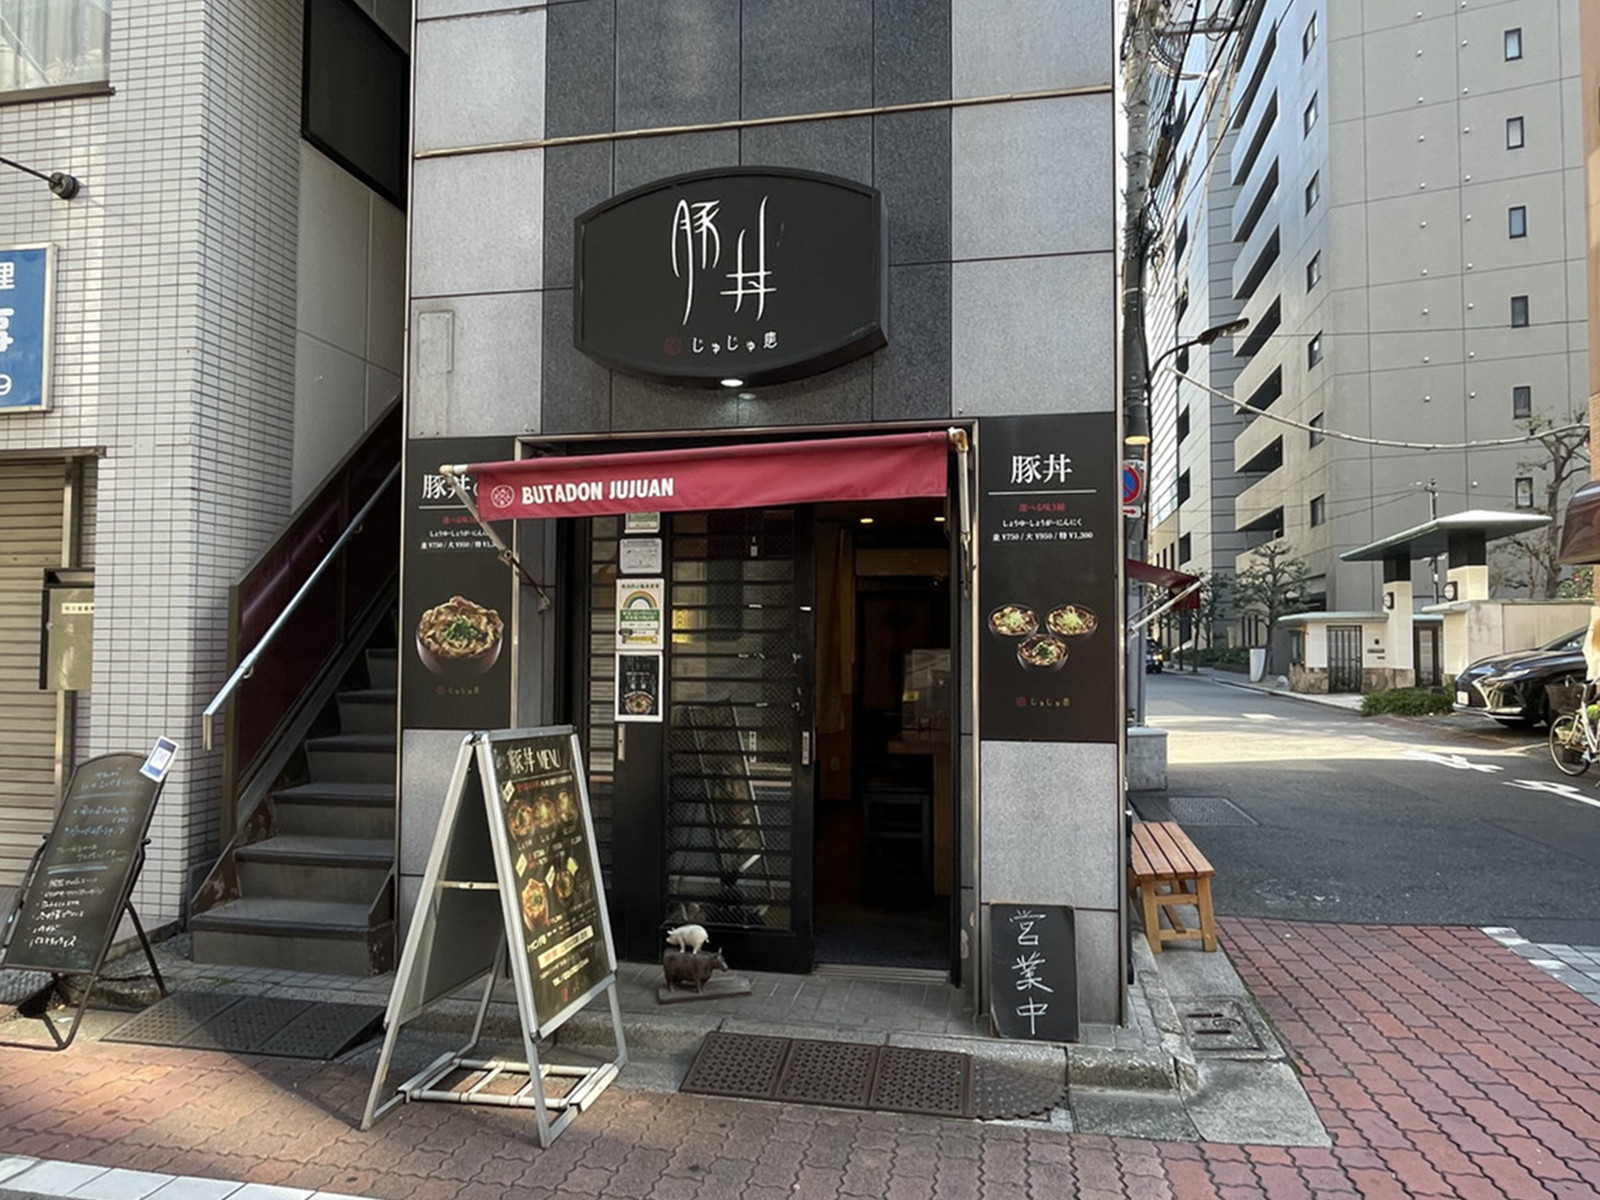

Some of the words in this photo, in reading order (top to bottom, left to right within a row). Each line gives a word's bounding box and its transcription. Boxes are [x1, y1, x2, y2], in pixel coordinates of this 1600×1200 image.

[1010, 453, 1073, 484] 豚丼
[521, 481, 603, 505] BUTADON
[608, 477, 674, 500] JUJUAN
[1009, 909, 1054, 1035] 営業中
